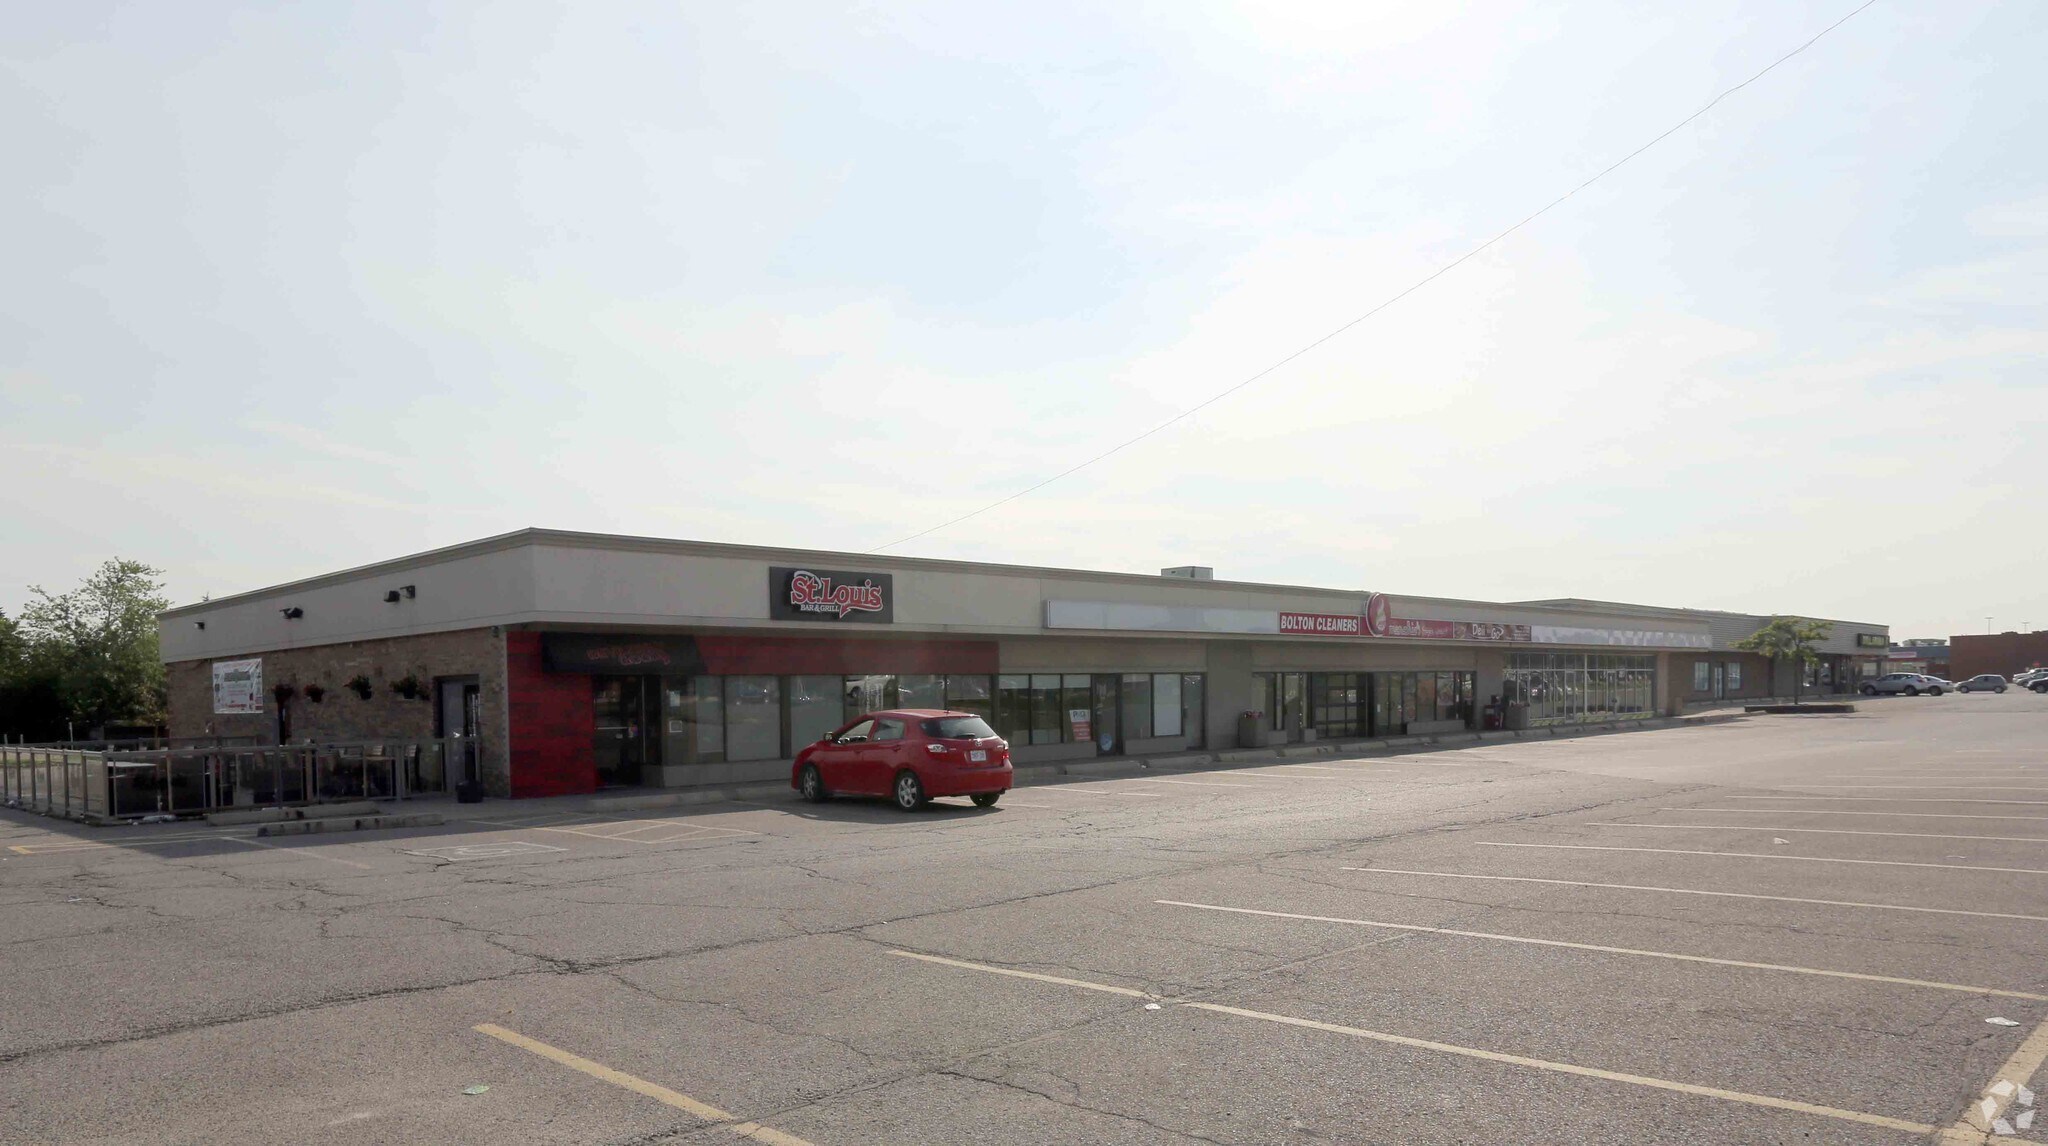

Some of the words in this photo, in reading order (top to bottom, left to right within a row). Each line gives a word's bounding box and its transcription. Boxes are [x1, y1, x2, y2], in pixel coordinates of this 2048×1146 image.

[814, 604, 821, 612] &
[1281, 615, 1314, 630] BOLTON
[1317, 617, 1358, 632] CLEANERS
